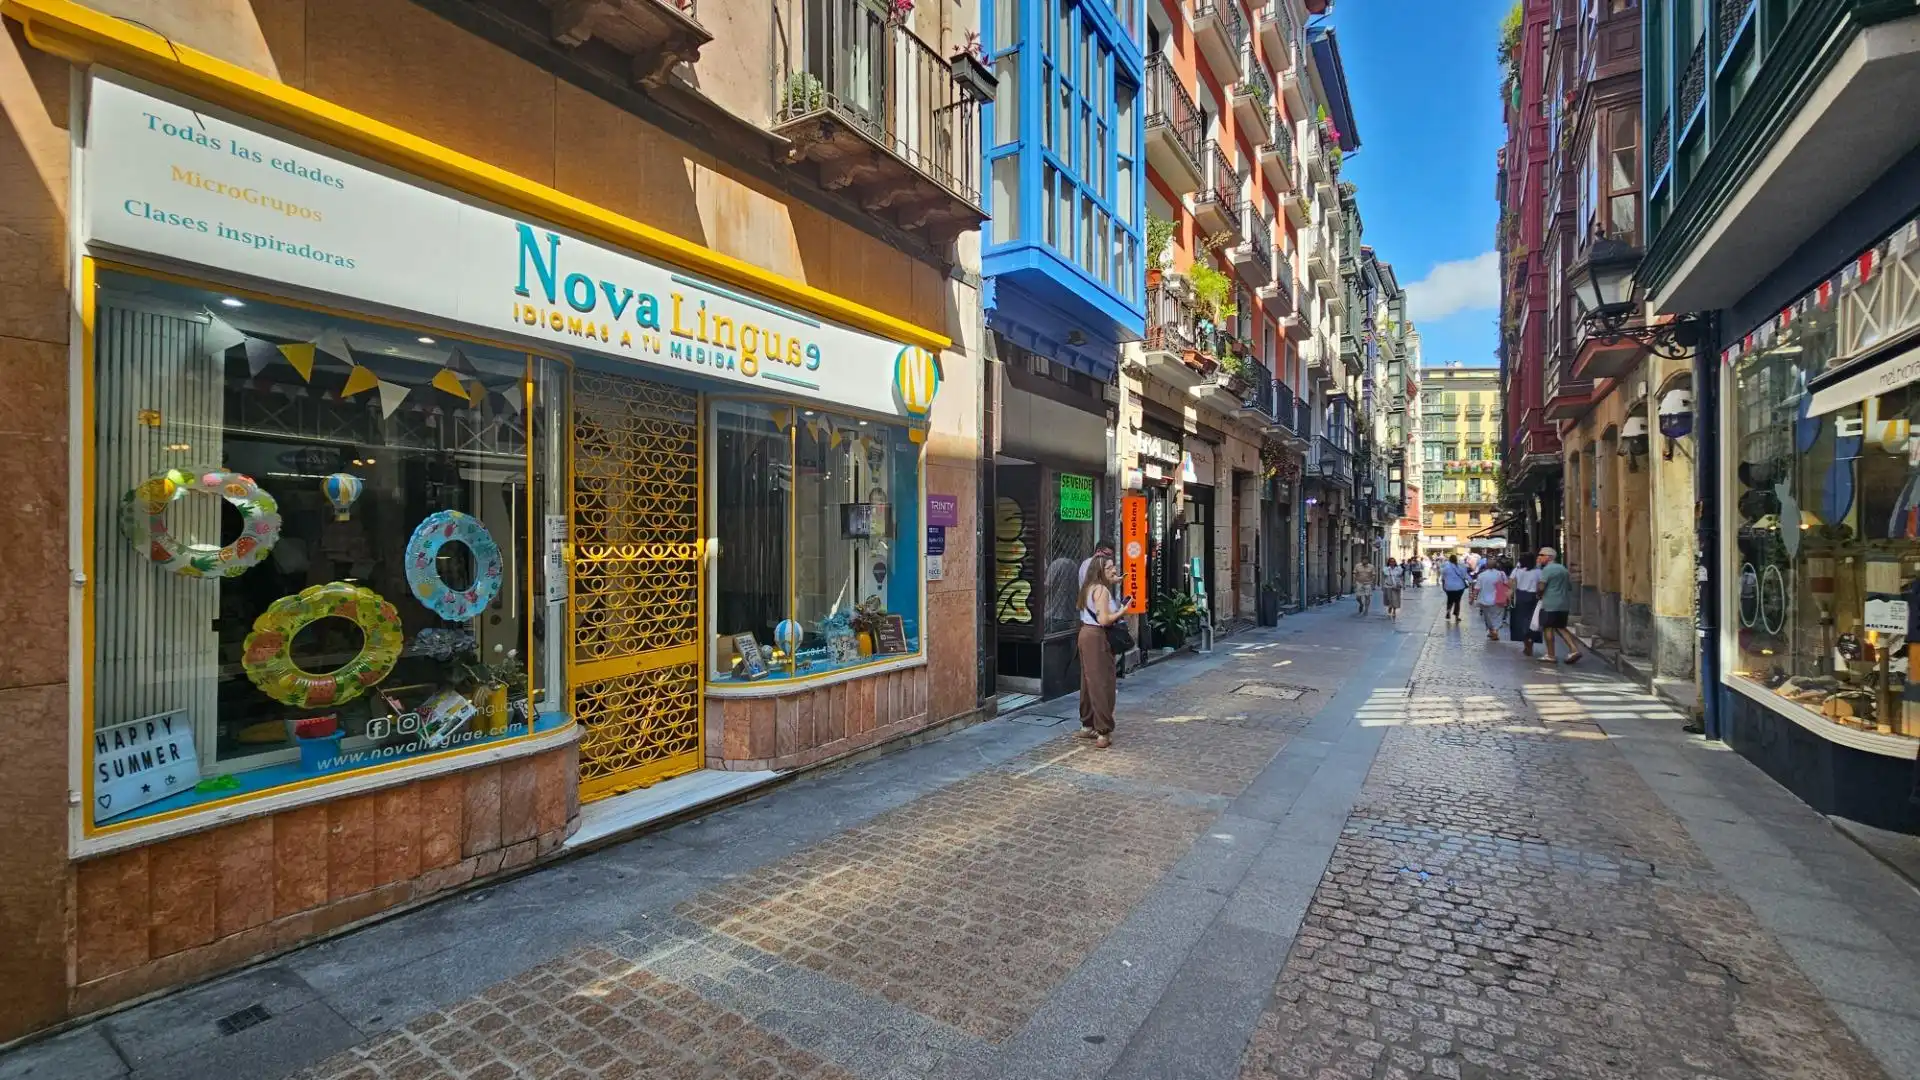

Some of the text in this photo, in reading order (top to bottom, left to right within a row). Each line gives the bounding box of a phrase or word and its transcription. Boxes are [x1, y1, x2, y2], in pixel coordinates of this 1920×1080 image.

[142, 111, 345, 190] Todas las edades
[170, 164, 323, 222] MicroGrupos
[123, 199, 356, 270] Clases inspiradoras
[513, 302, 736, 371] IDIOMAS A TU MEDIDA
[930, 500, 955, 511] TRINITY
[1130, 563, 1138, 608] expert
[96, 717, 171, 754] HAPPY
[98, 743, 180, 783] SUMMER
